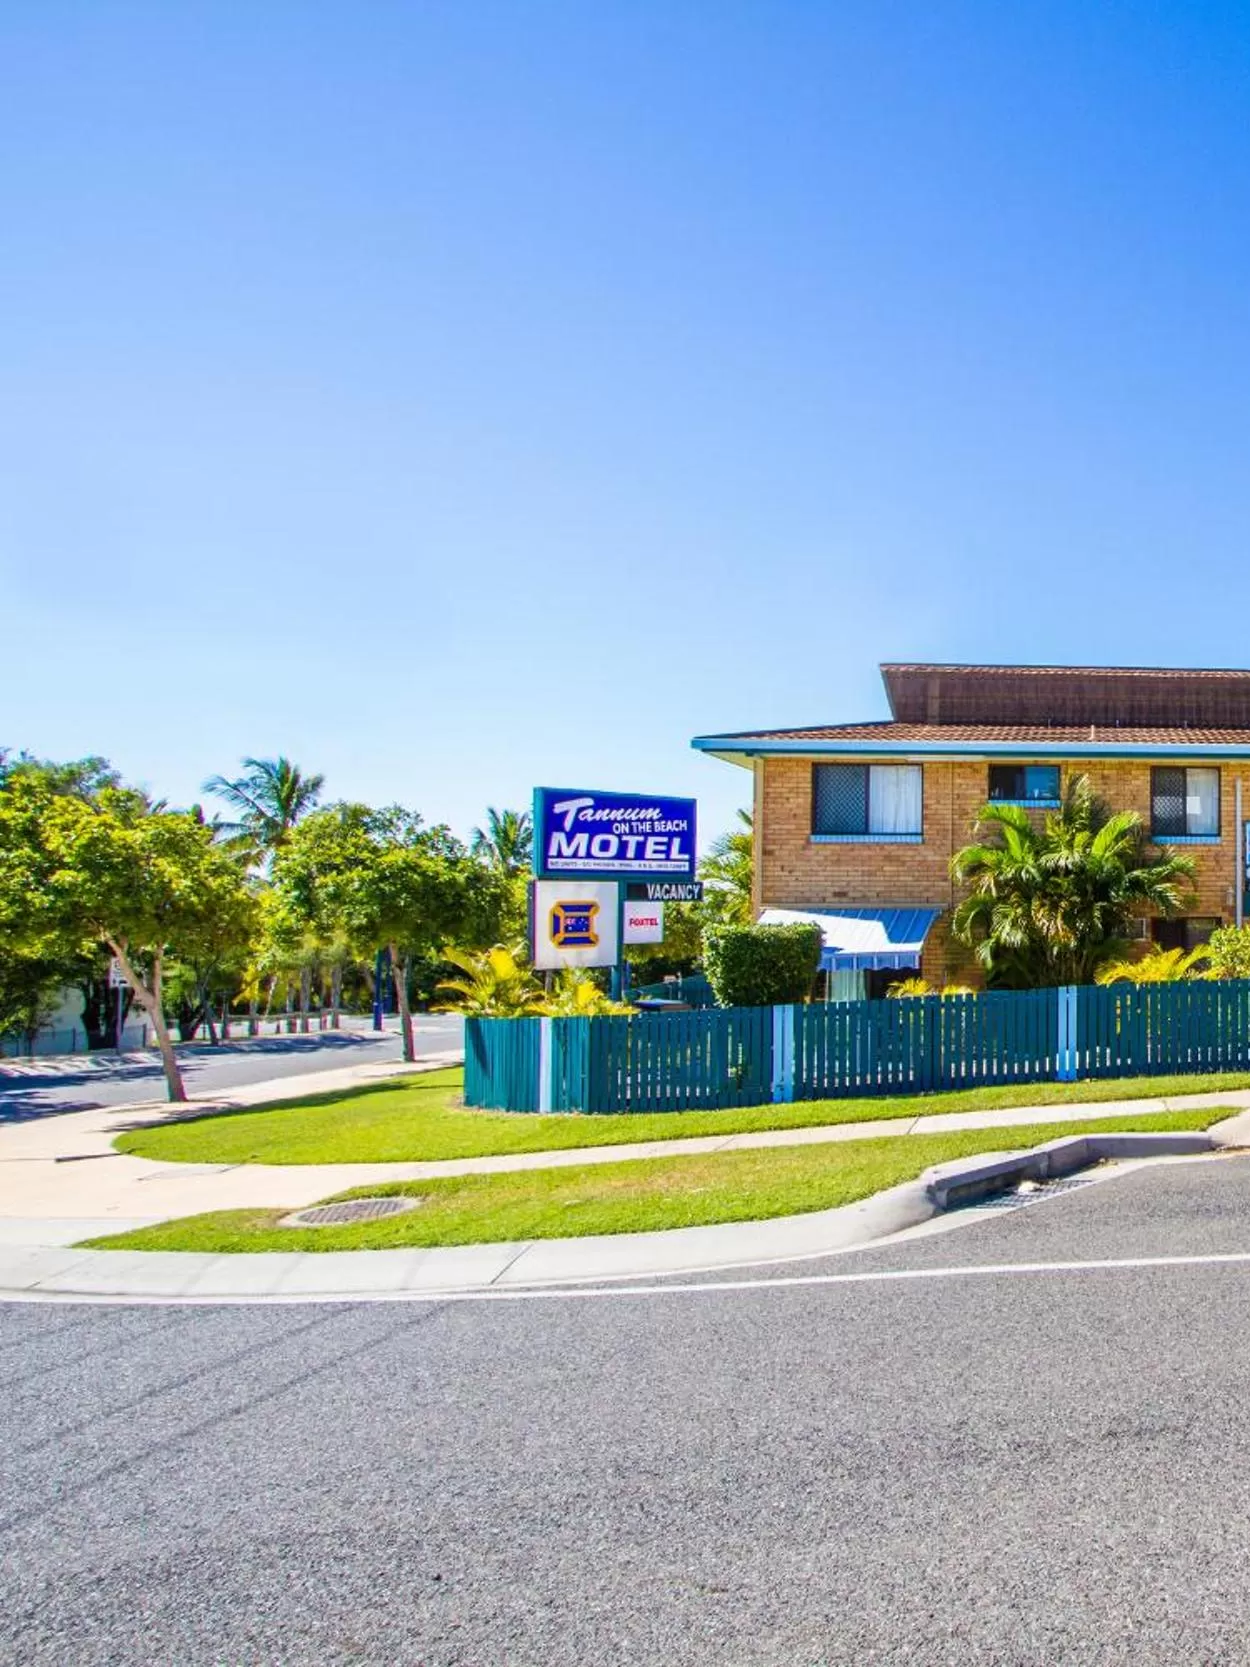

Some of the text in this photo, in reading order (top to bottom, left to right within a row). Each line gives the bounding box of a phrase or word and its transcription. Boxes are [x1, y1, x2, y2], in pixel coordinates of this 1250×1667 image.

[553, 797, 662, 832] Tannum
[612, 820, 688, 834] ON THE BEACH
[548, 832, 690, 859] MOTEL
[647, 882, 700, 899] VACANCY
[629, 917, 658, 927] FOXTEL
